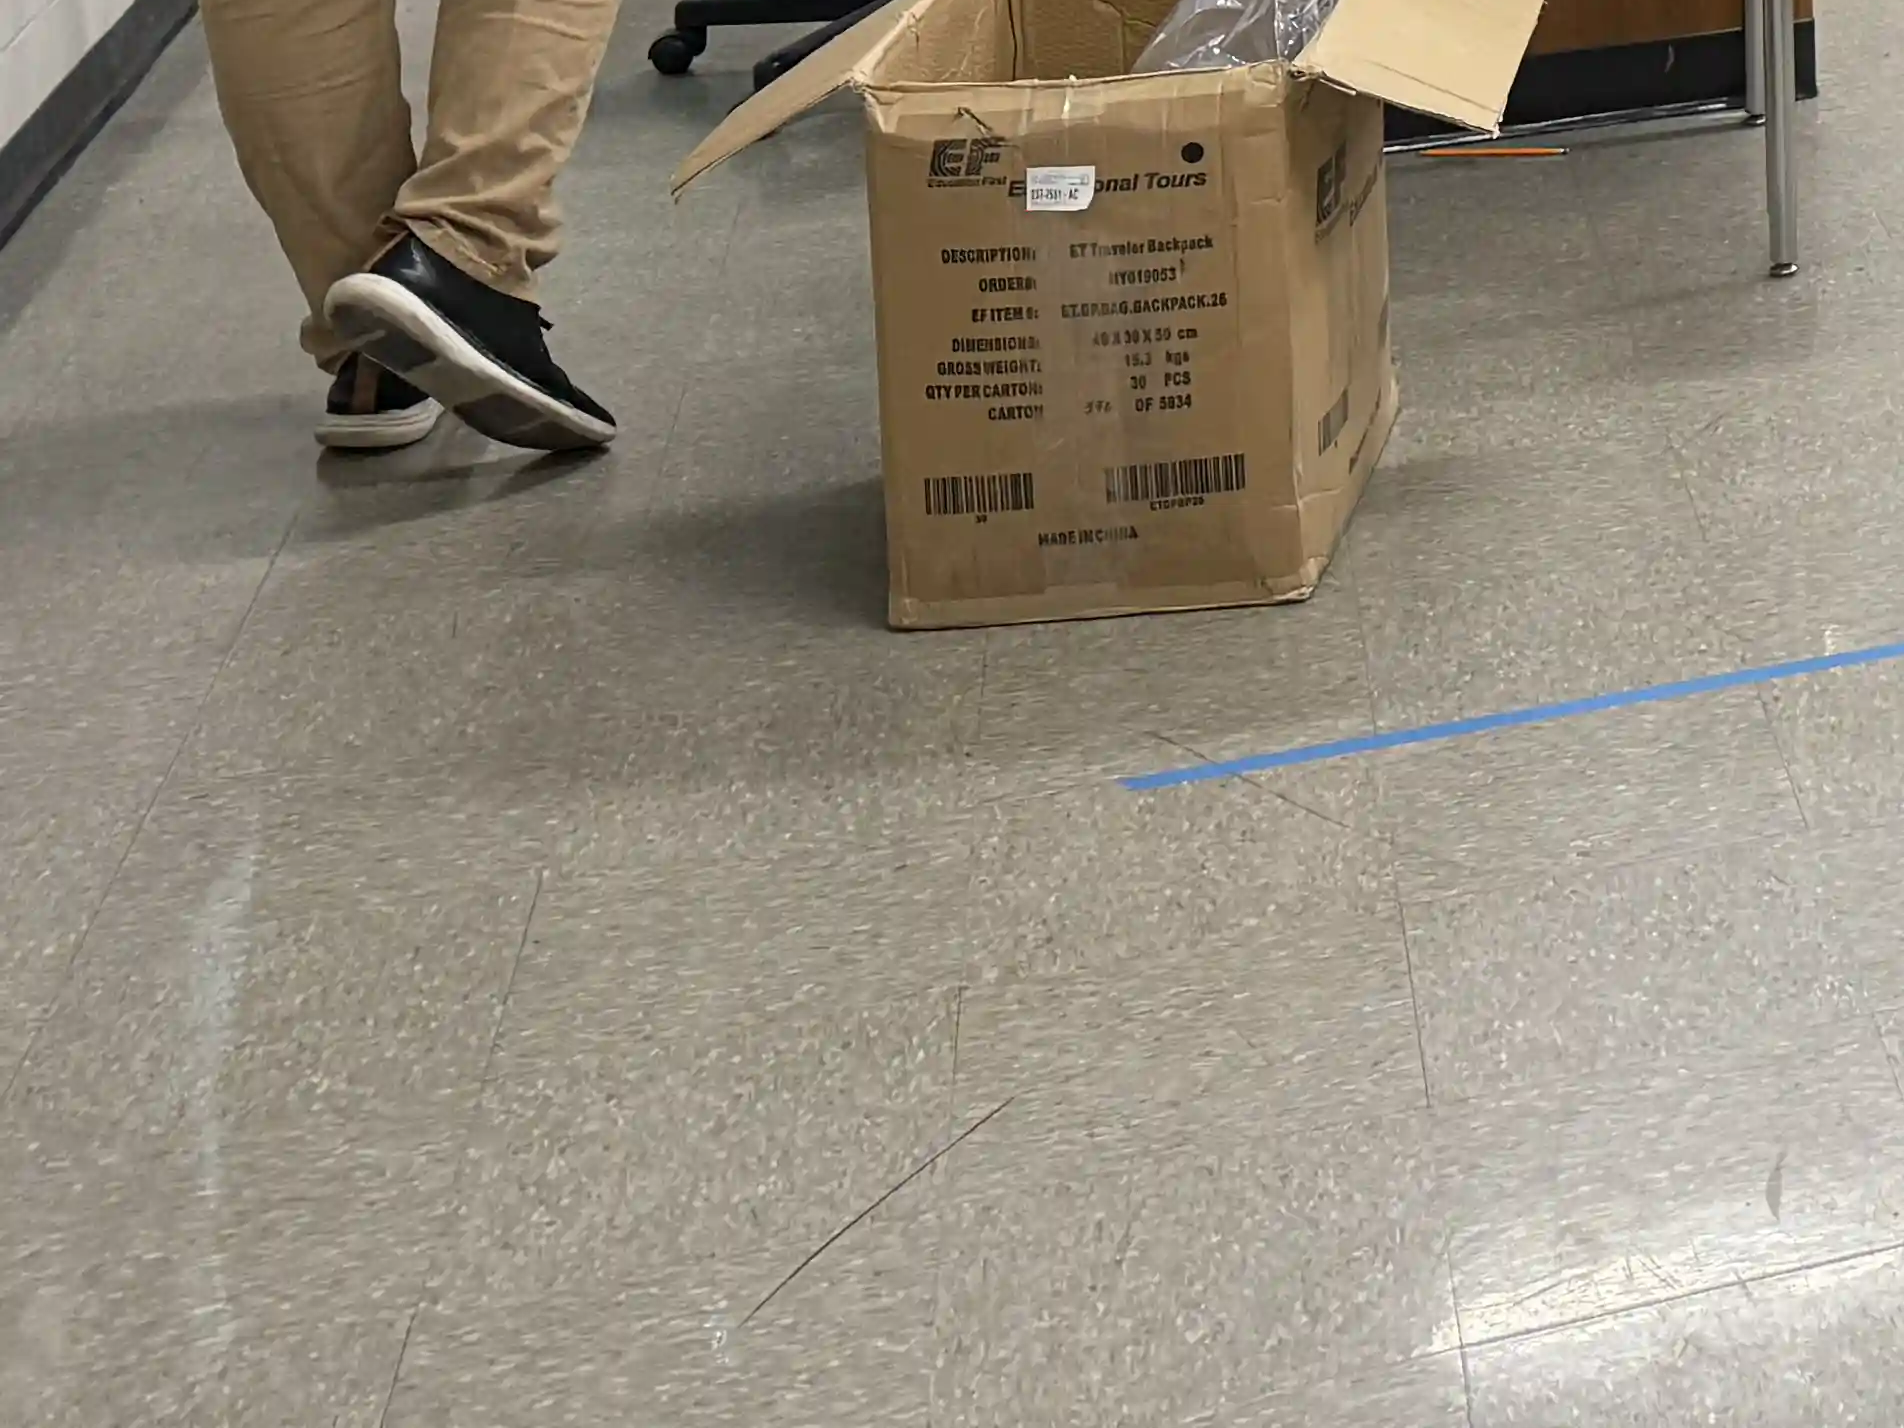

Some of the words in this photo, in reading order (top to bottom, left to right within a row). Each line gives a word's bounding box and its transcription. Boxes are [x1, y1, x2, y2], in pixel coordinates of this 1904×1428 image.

[1144, 170, 1207, 189] Tours
[1147, 234, 1214, 255] Backpack
[989, 306, 1024, 323] ITEM
[1177, 326, 1199, 342] cm
[925, 384, 954, 401] QTY
[954, 383, 982, 400] PER
[1130, 375, 1148, 391] 30
[1164, 370, 1192, 388] PCS
[1135, 396, 1154, 413] OF
[1037, 530, 1076, 547] MADE
